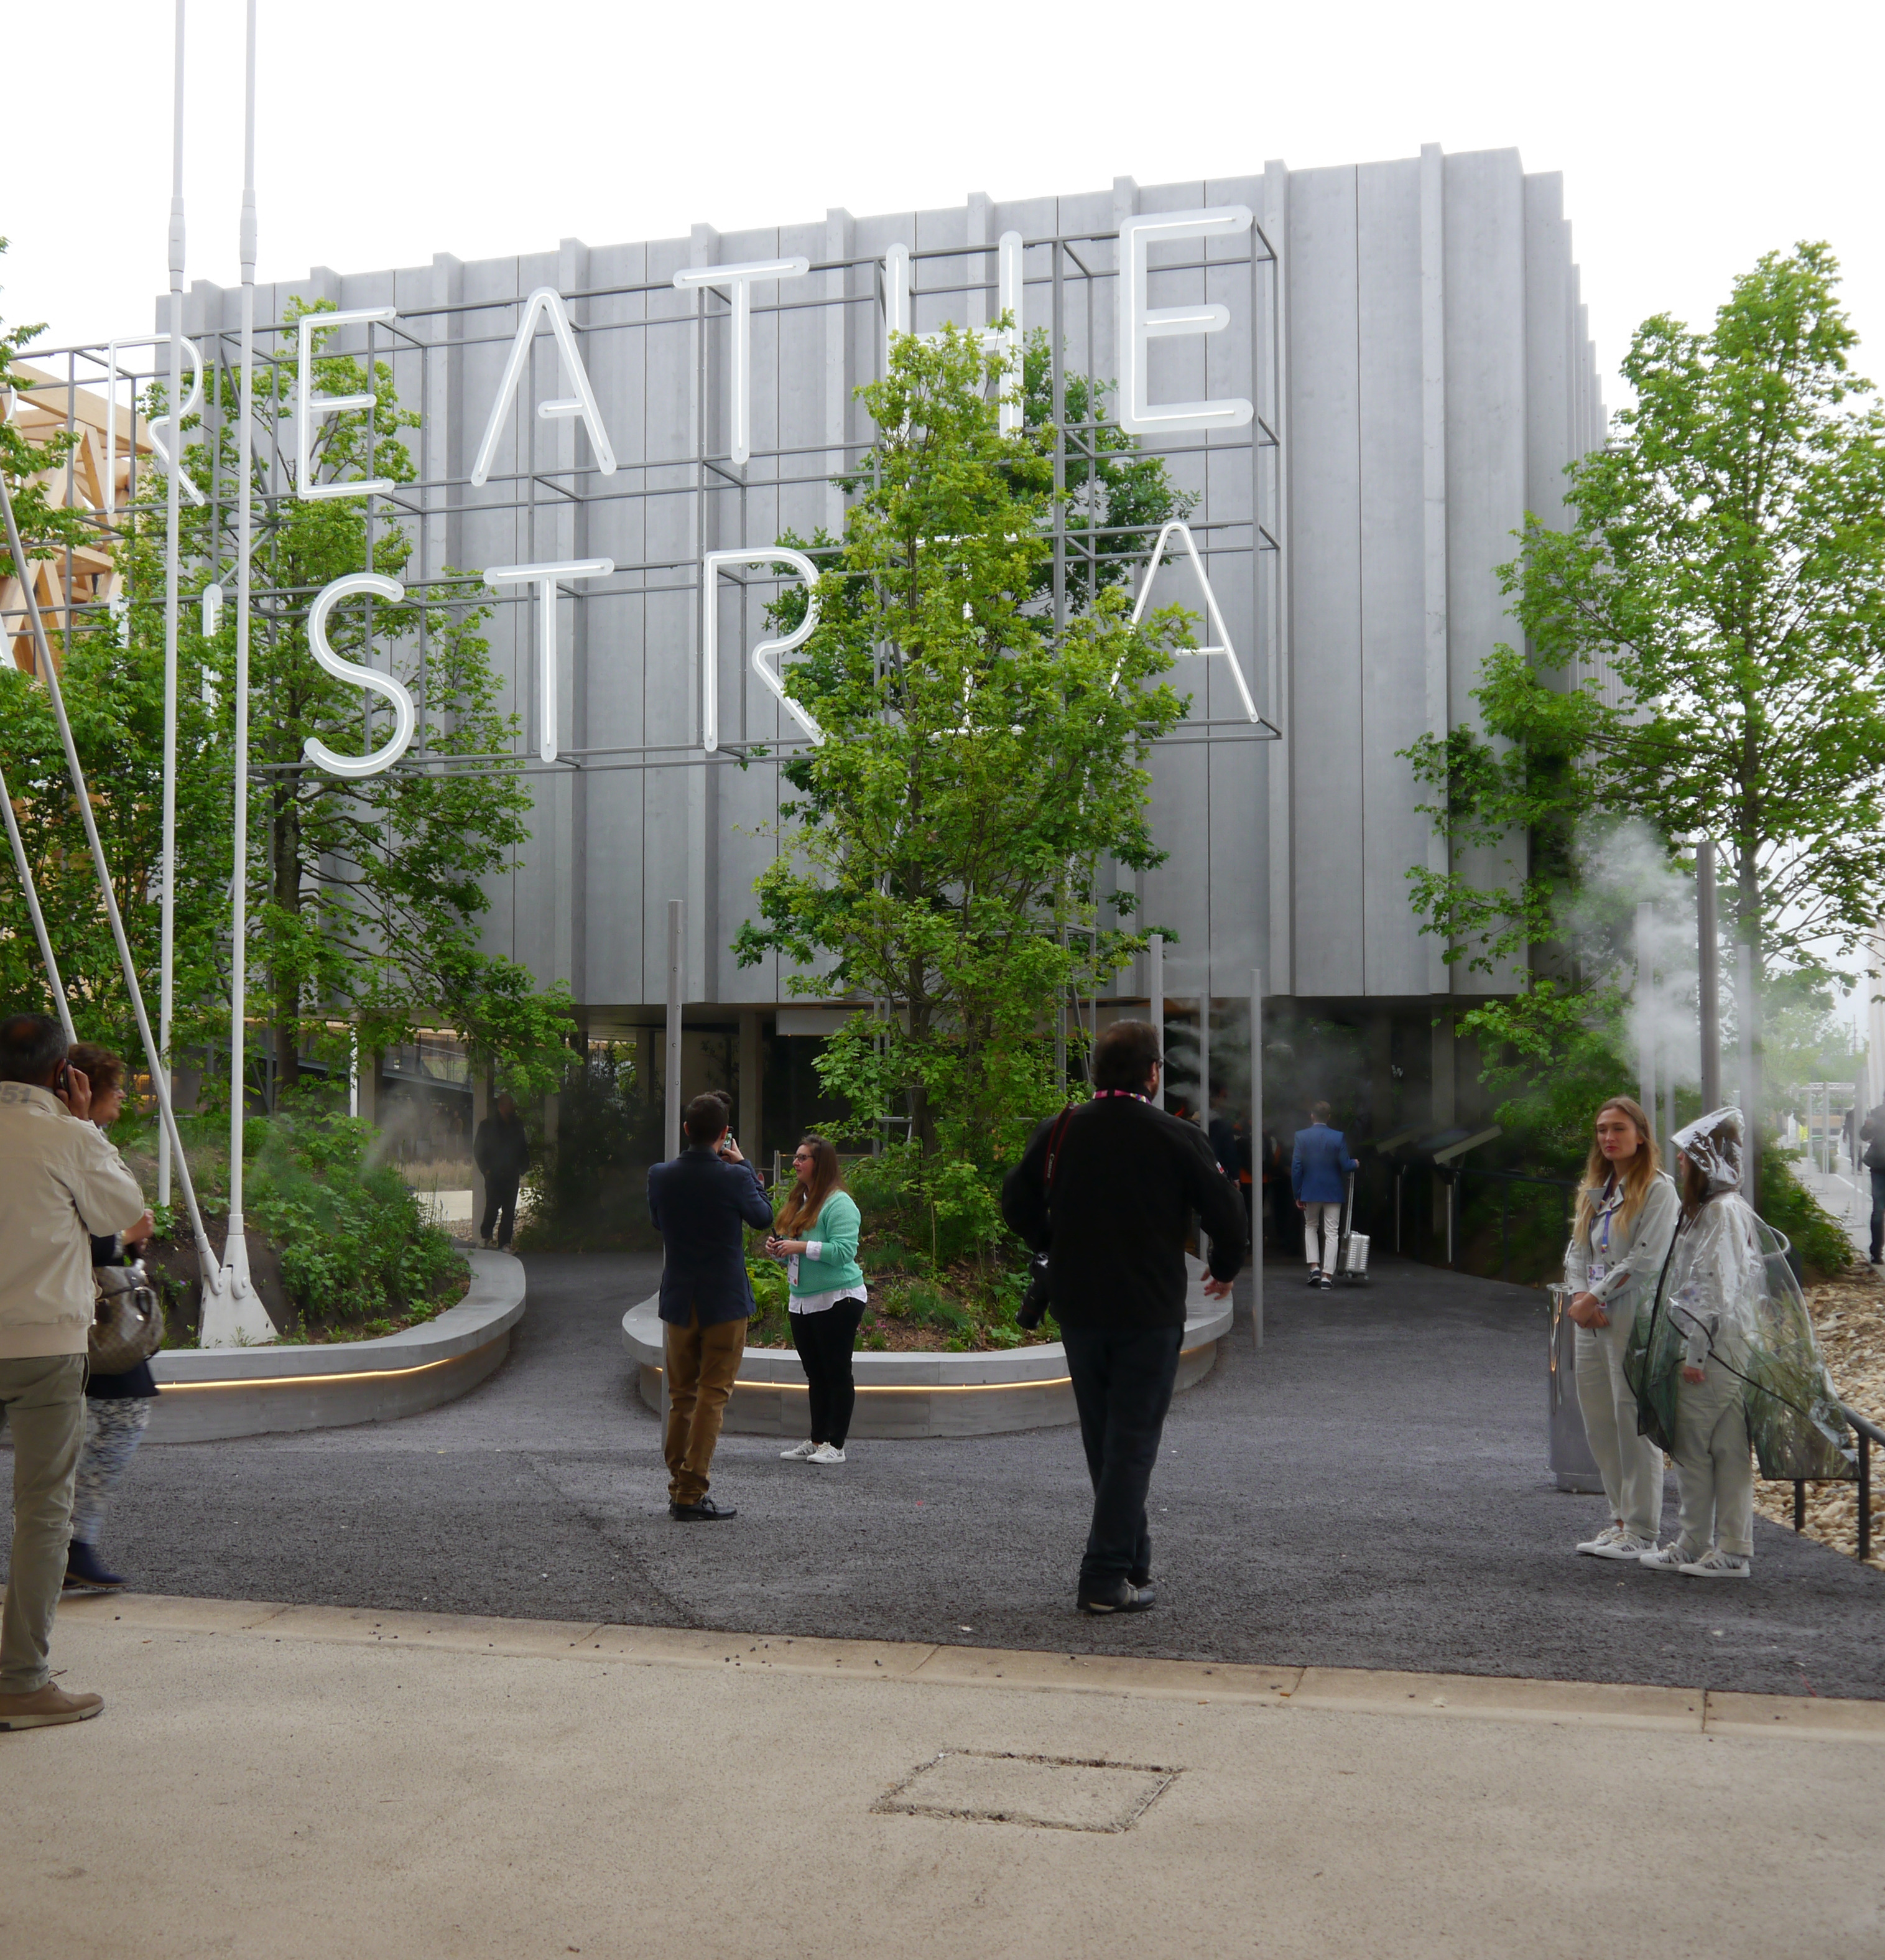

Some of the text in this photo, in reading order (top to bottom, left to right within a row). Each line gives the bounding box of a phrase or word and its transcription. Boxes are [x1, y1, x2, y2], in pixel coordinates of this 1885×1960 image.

[0, 204, 1254, 514] REATHE
[0, 522, 1259, 777] STRA
[0, 1084, 31, 1103] 51
